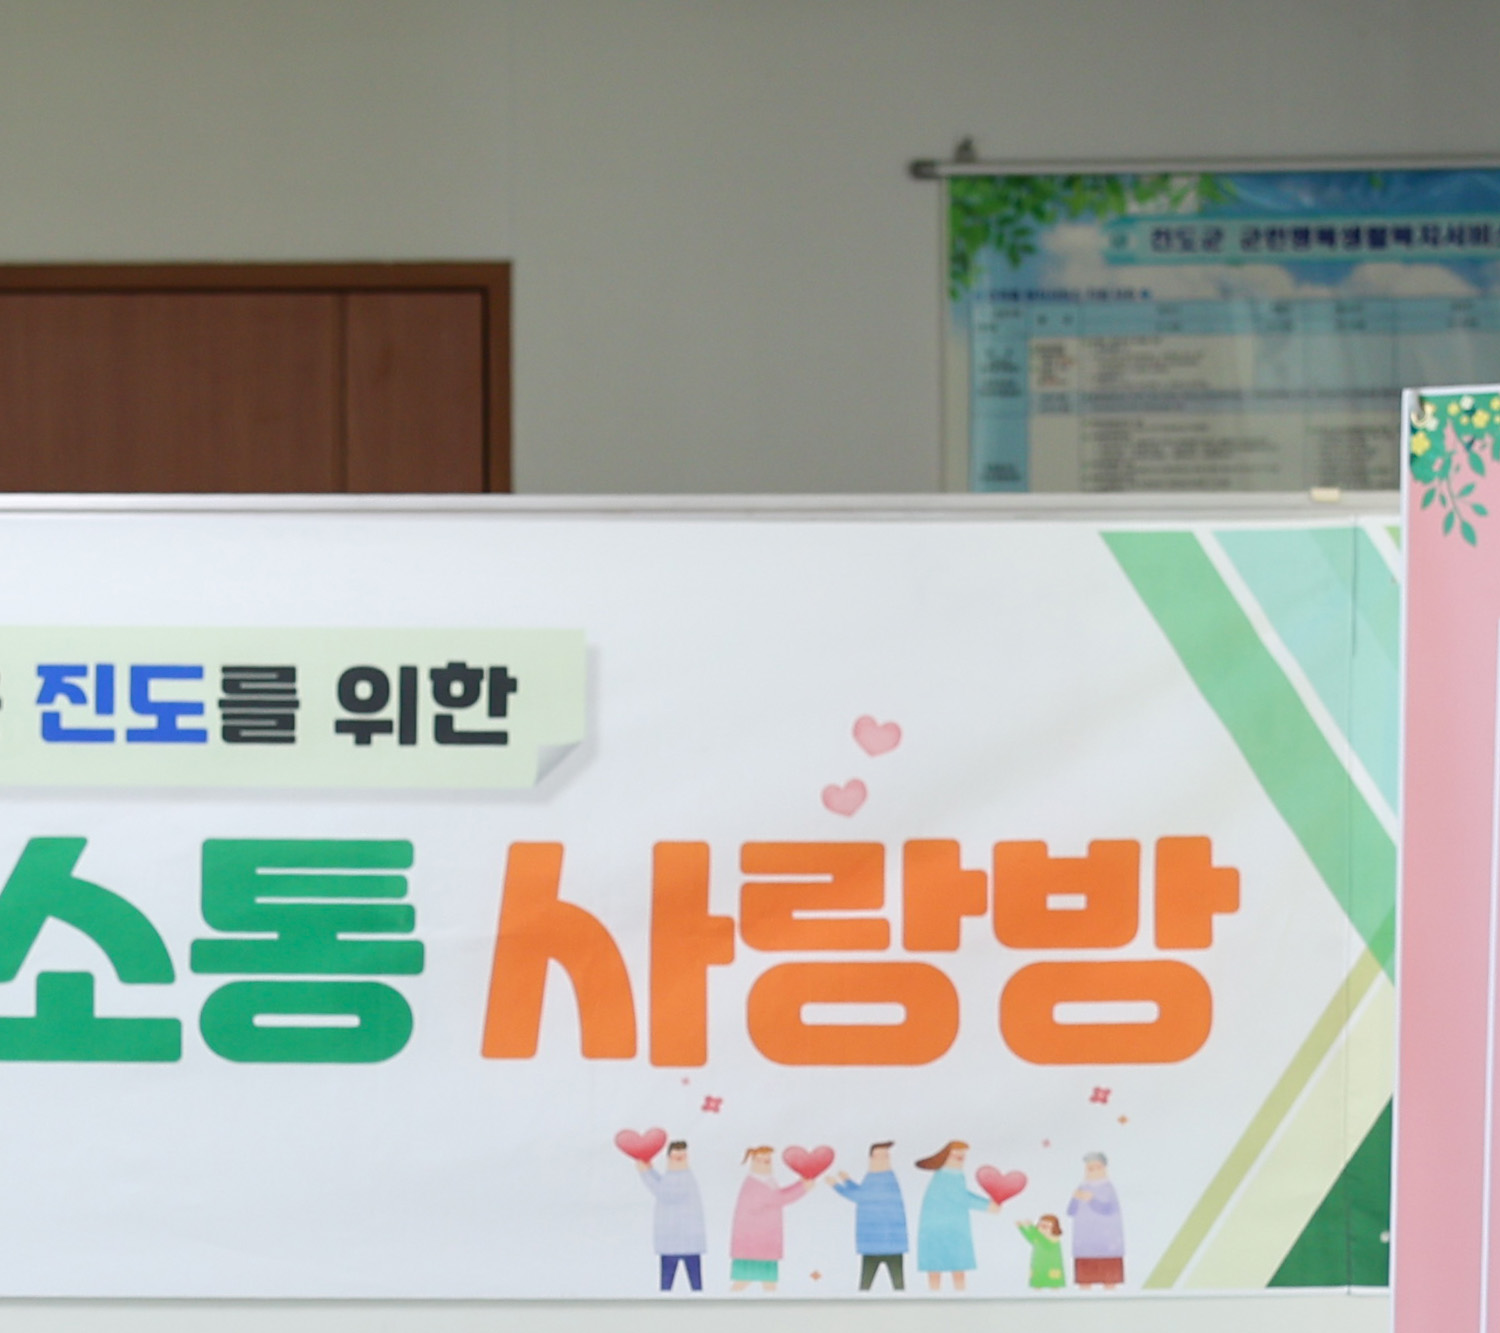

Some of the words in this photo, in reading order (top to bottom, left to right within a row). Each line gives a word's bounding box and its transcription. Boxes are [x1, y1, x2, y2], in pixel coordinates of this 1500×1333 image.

[34, 663, 302, 745] 진도를
[334, 661, 519, 747] 위한
[481, 836, 1241, 1067] 사랑방
